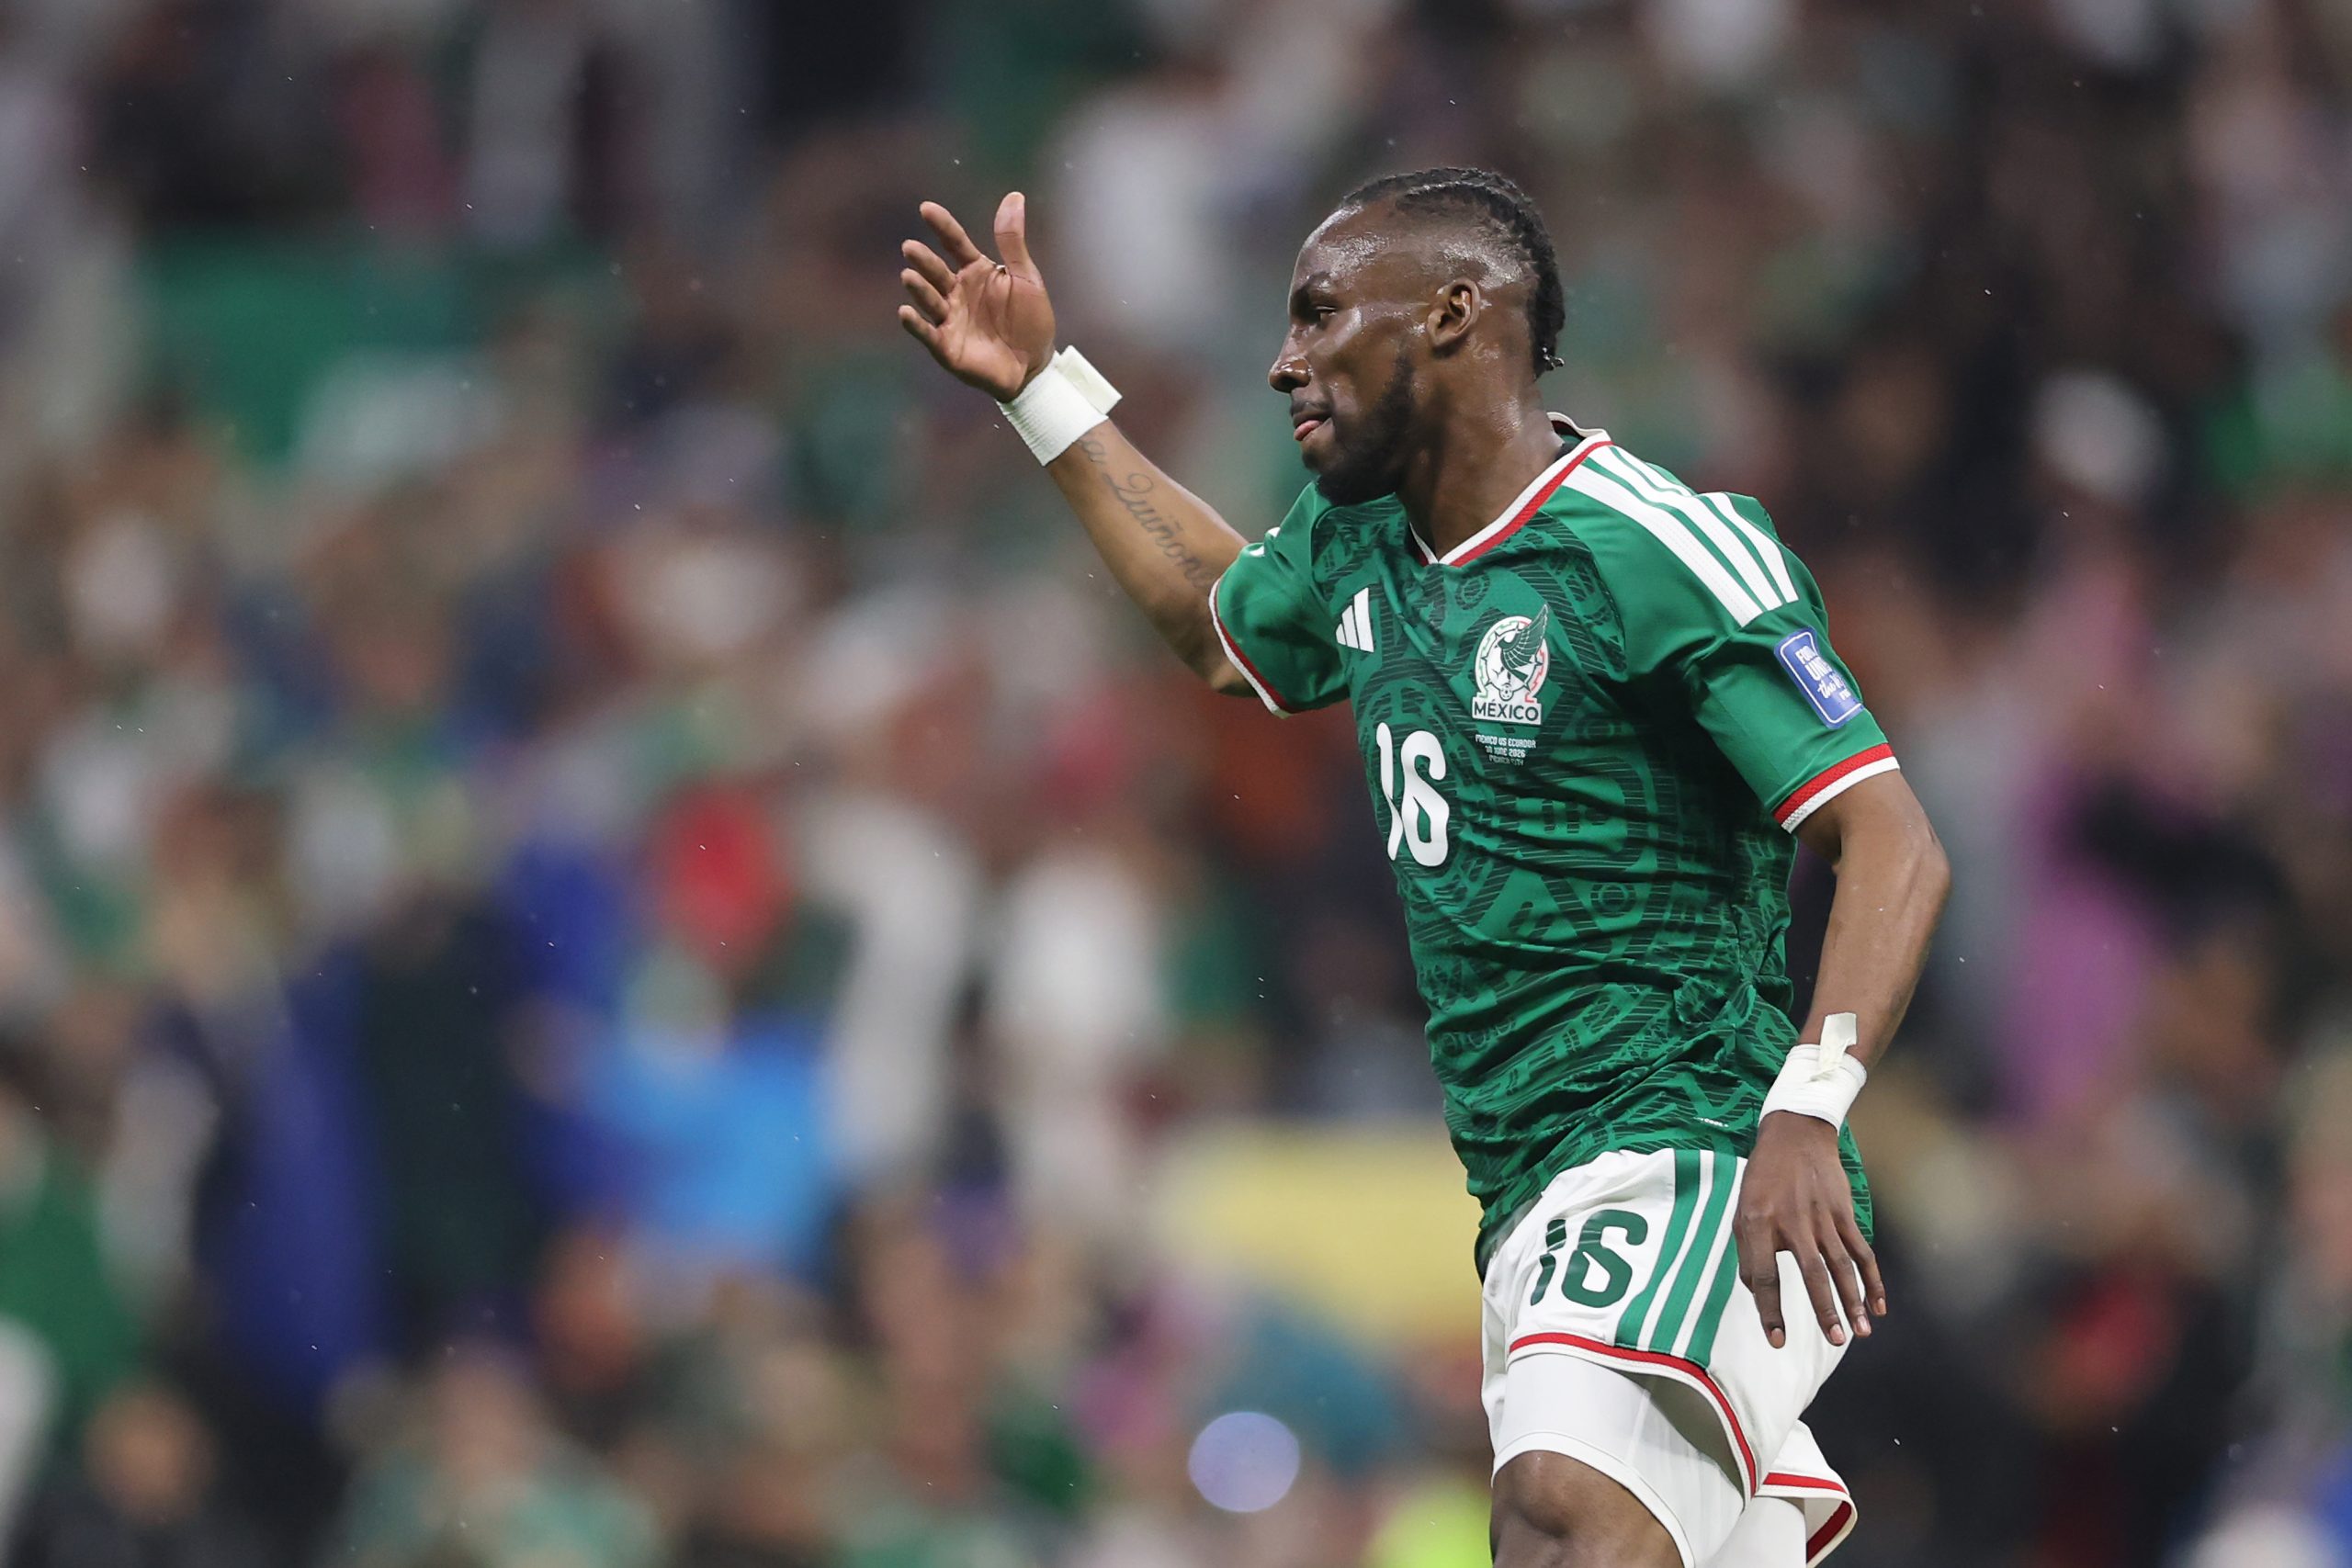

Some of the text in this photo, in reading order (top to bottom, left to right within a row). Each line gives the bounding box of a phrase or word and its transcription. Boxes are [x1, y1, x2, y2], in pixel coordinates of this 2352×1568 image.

[1102, 472, 1213, 590] Quiñone
[1474, 698, 1539, 721] MÉXICO
[1508, 738, 1536, 749] ECUADOR
[1509, 748, 1526, 758] 2026
[1375, 722, 1450, 867] 16
[1530, 1209, 1648, 1308] 16
